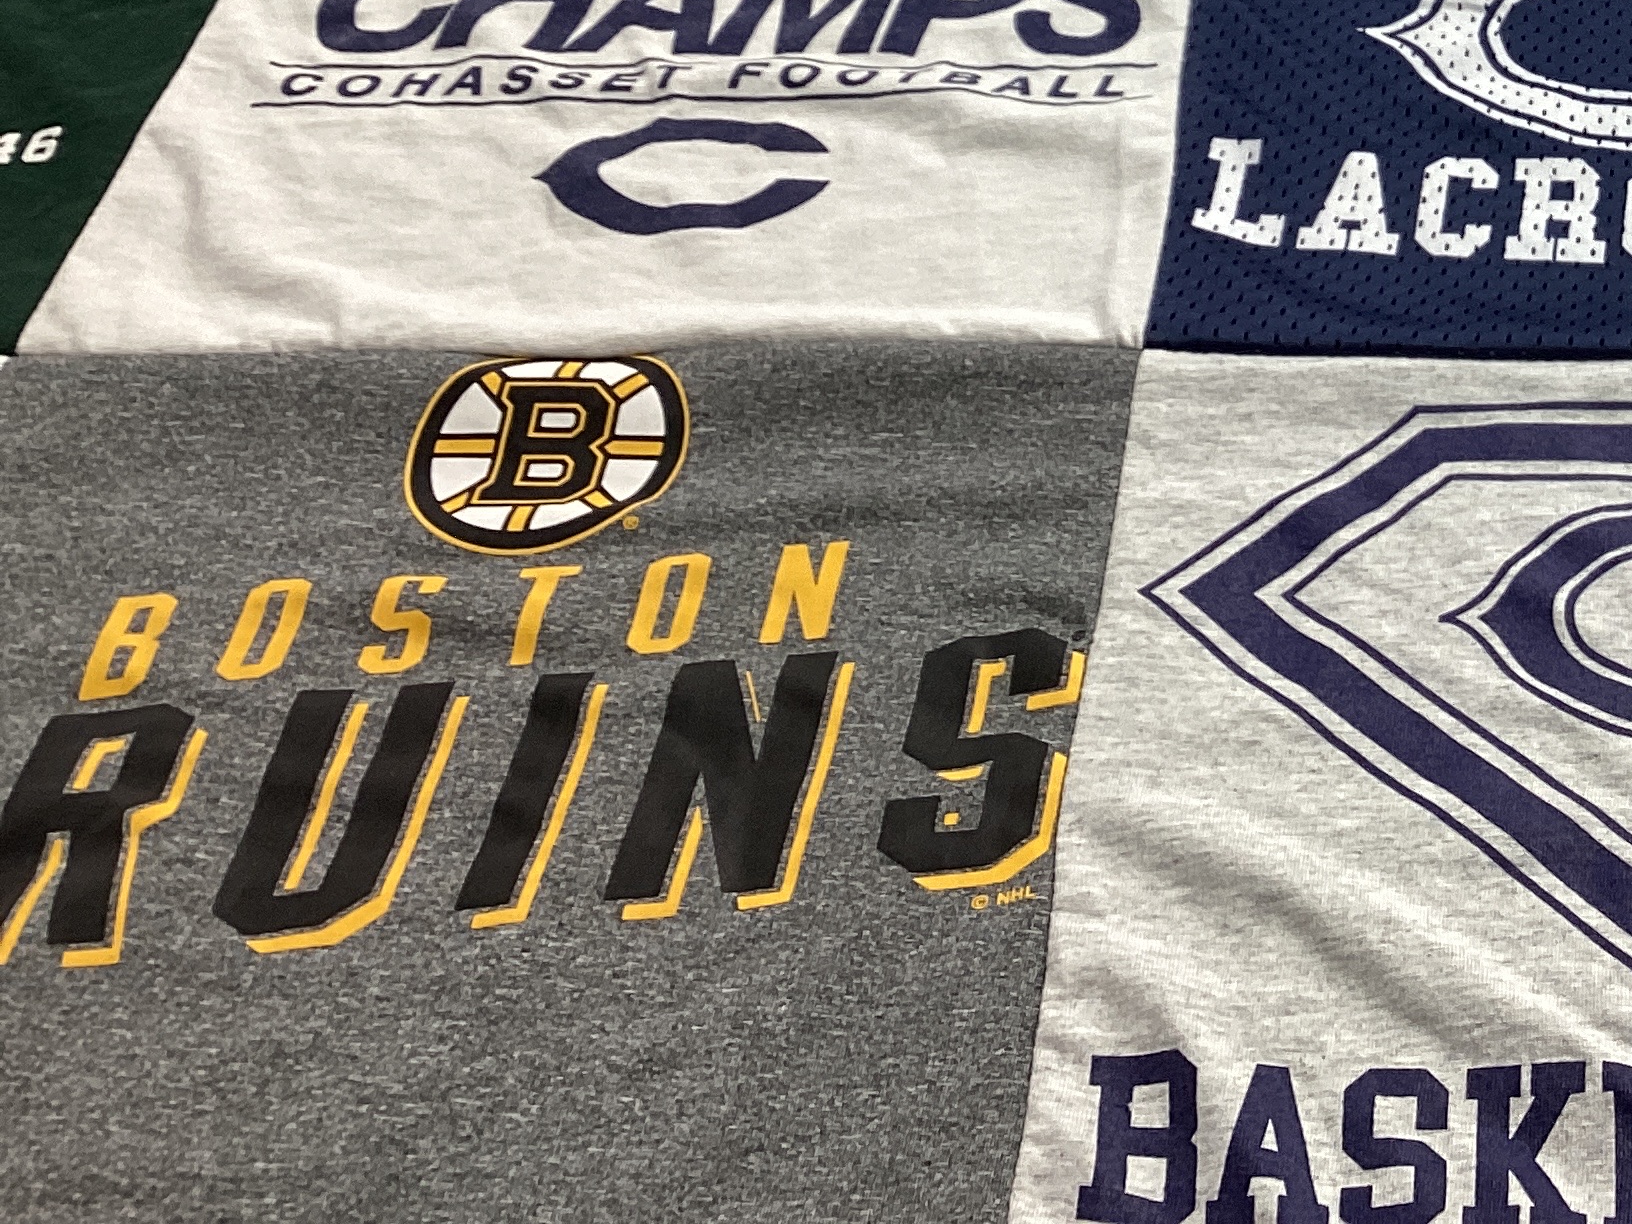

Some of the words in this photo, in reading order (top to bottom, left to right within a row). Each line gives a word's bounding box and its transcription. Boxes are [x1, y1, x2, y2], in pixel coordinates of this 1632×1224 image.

[279, 62, 694, 99] COHASSET
[728, 62, 1126, 99] FOOTBALL
[471, 382, 615, 506] B
[79, 540, 849, 701] BOSTON
[996, 885, 1036, 905] NHL
